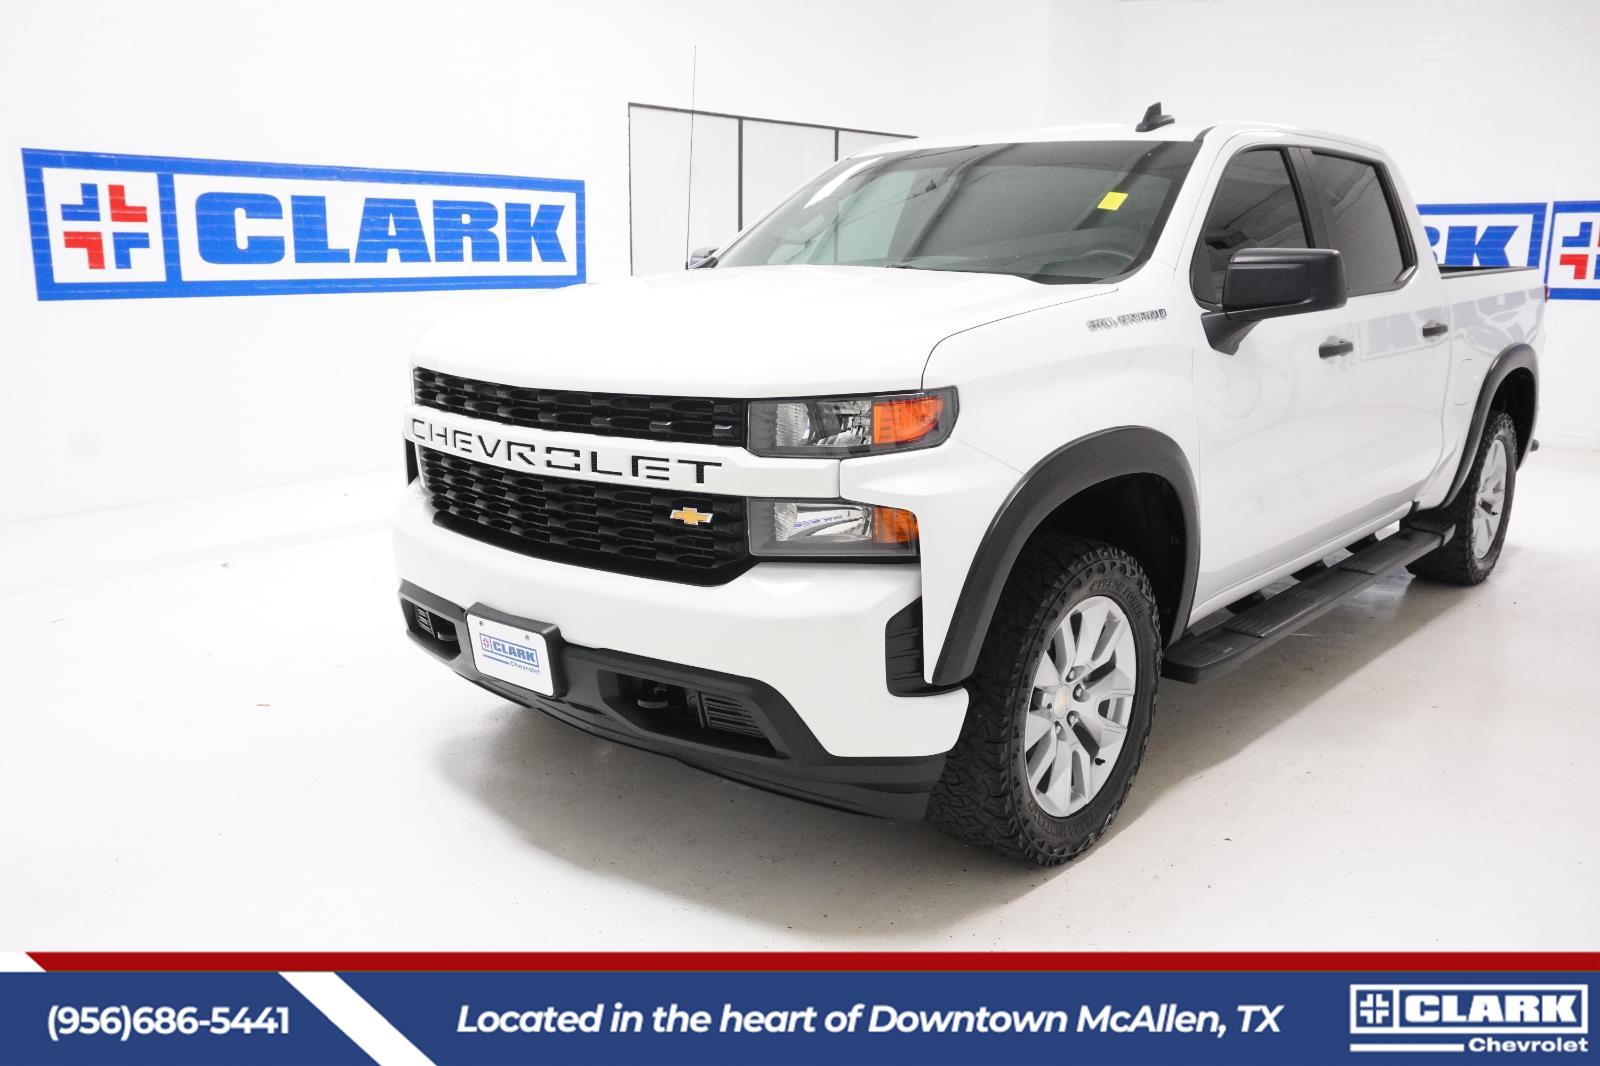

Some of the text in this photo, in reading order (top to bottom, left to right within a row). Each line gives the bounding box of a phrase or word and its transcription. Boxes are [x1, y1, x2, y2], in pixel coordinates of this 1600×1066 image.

[195, 190, 568, 265] CLARK
[411, 418, 723, 485] CHEVROLET
[492, 641, 537, 662] CLARK
[510, 661, 541, 674] Chevrolet
